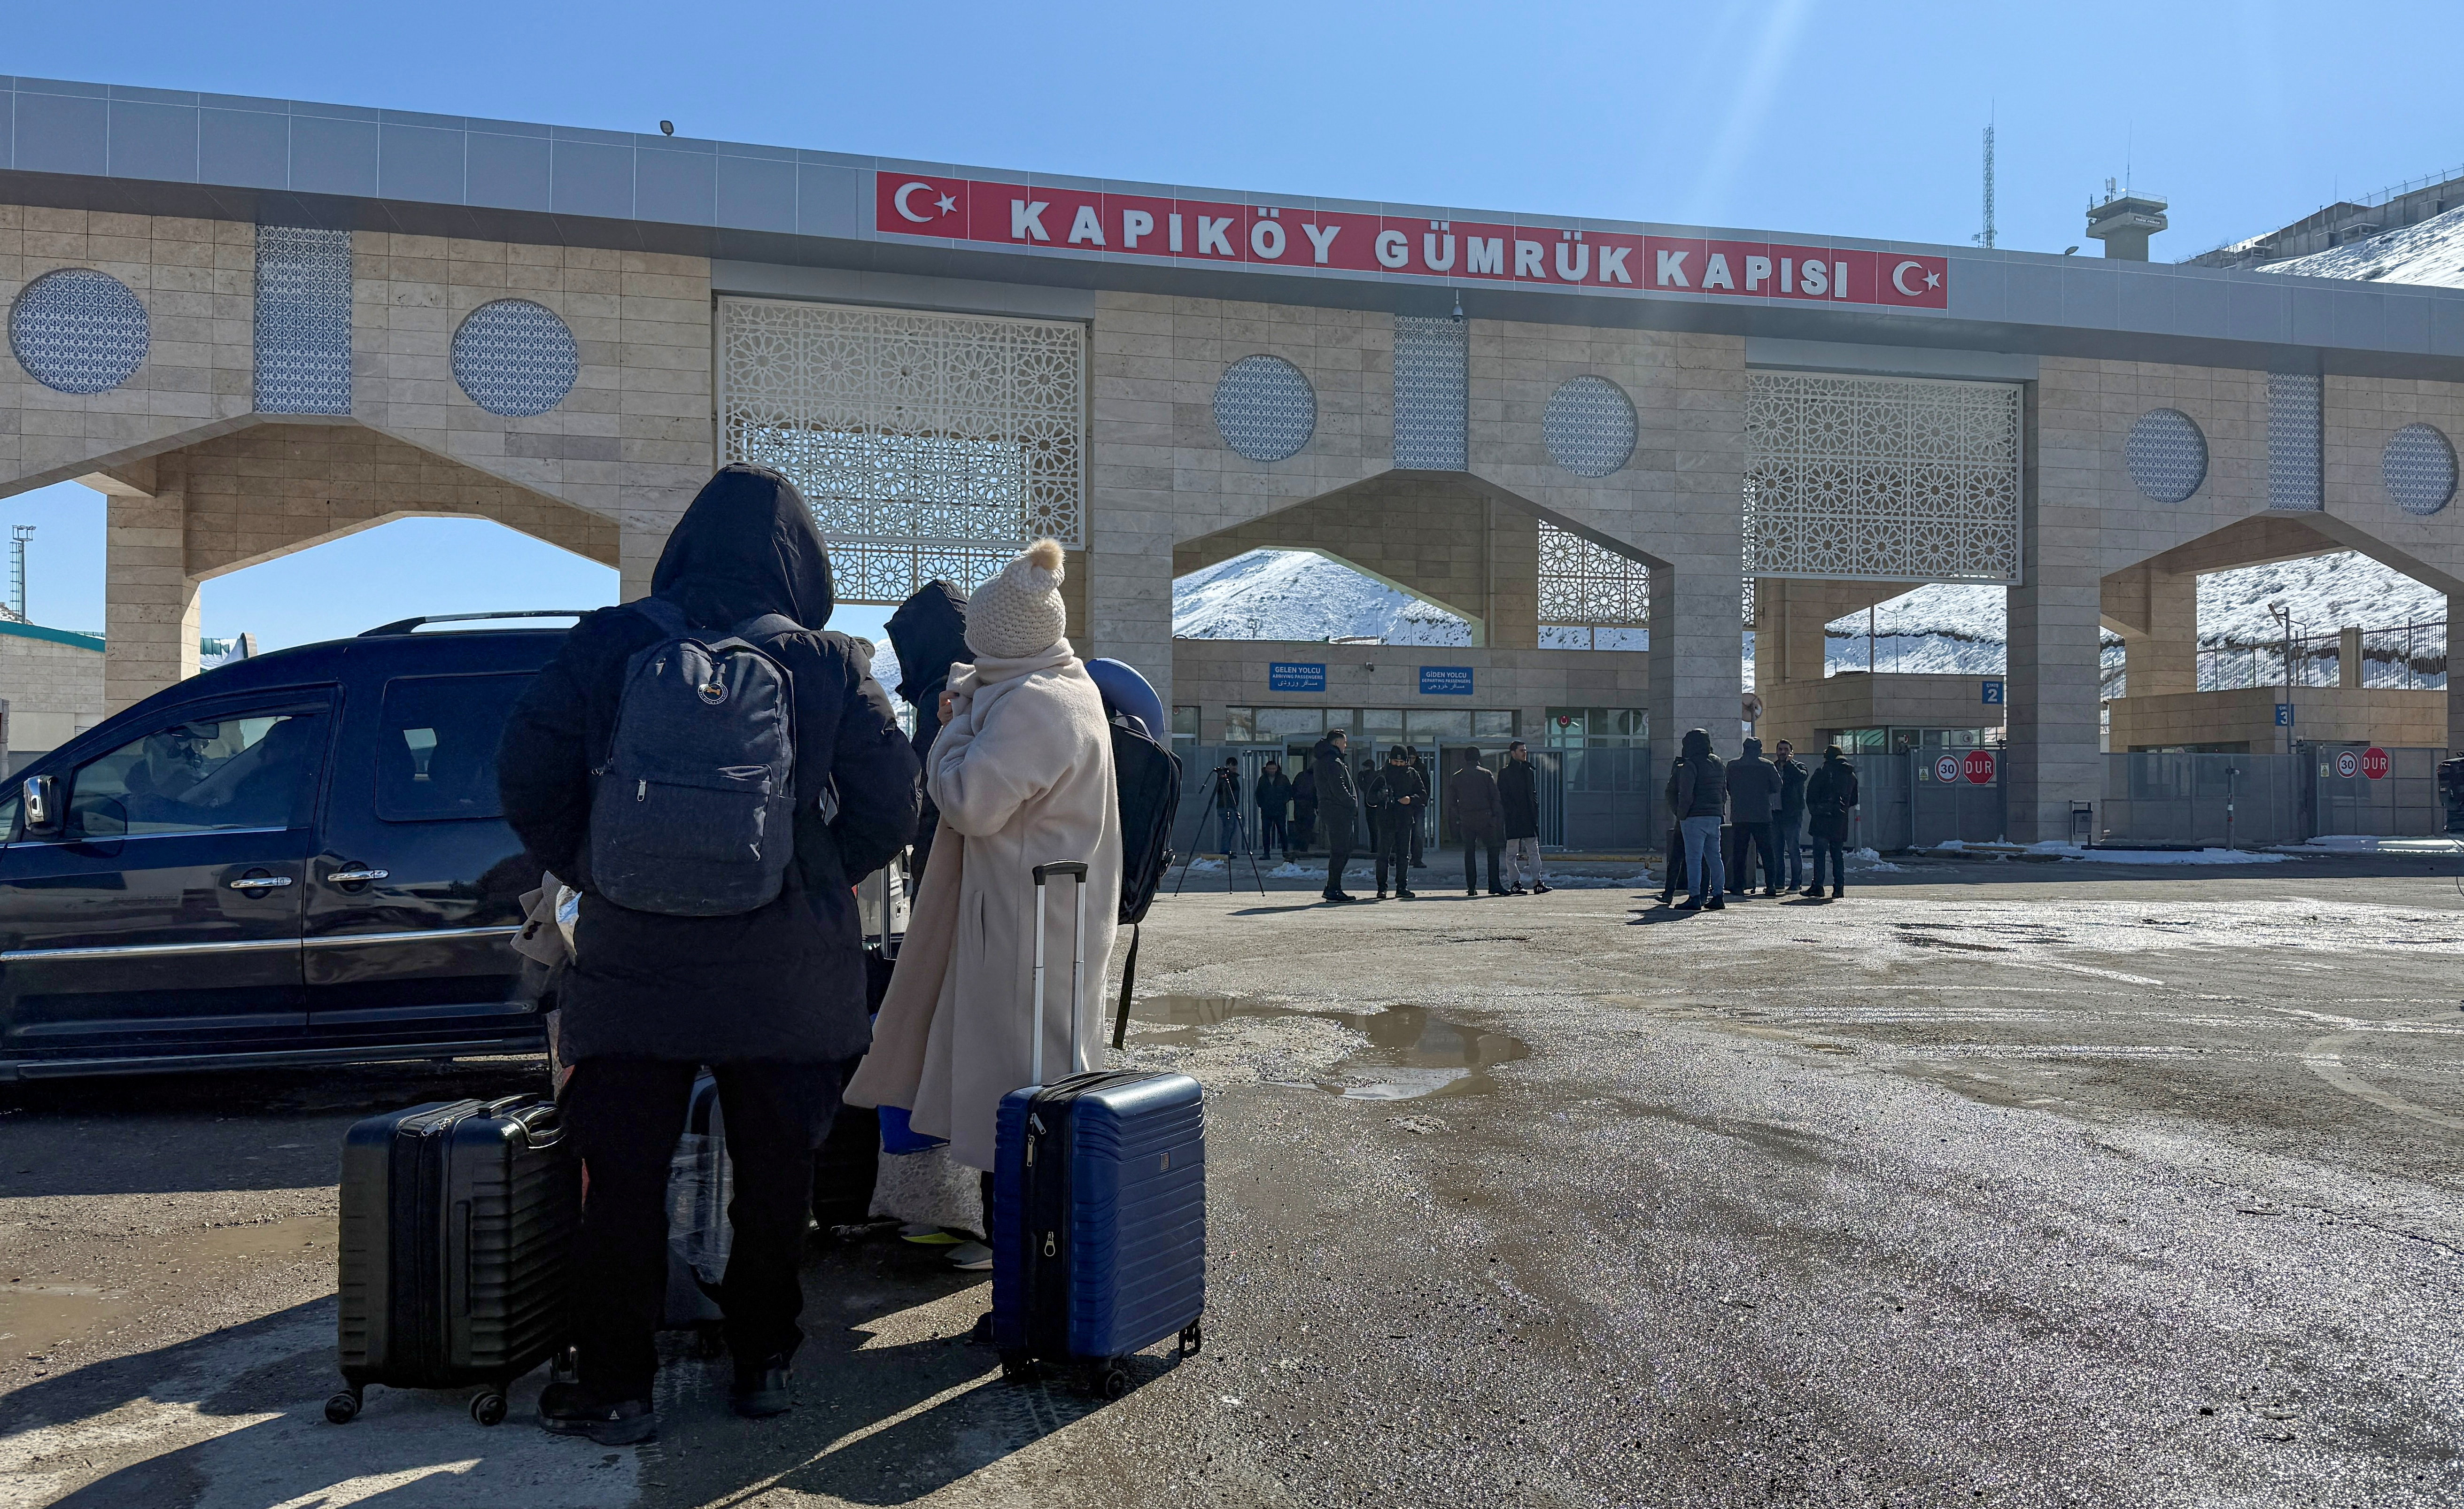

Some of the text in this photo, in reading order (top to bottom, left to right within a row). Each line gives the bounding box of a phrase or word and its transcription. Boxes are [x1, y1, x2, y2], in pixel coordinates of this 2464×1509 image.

[1010, 199, 1847, 298] KAPIKÖY GÜMRÜK KAPISI
[1988, 689, 1997, 702] 2
[2280, 711, 2287, 724] 3
[1940, 764, 1954, 774] 30
[1966, 761, 1992, 774] DUR
[2341, 760, 2354, 769] 30
[2363, 757, 2387, 770] DUR
